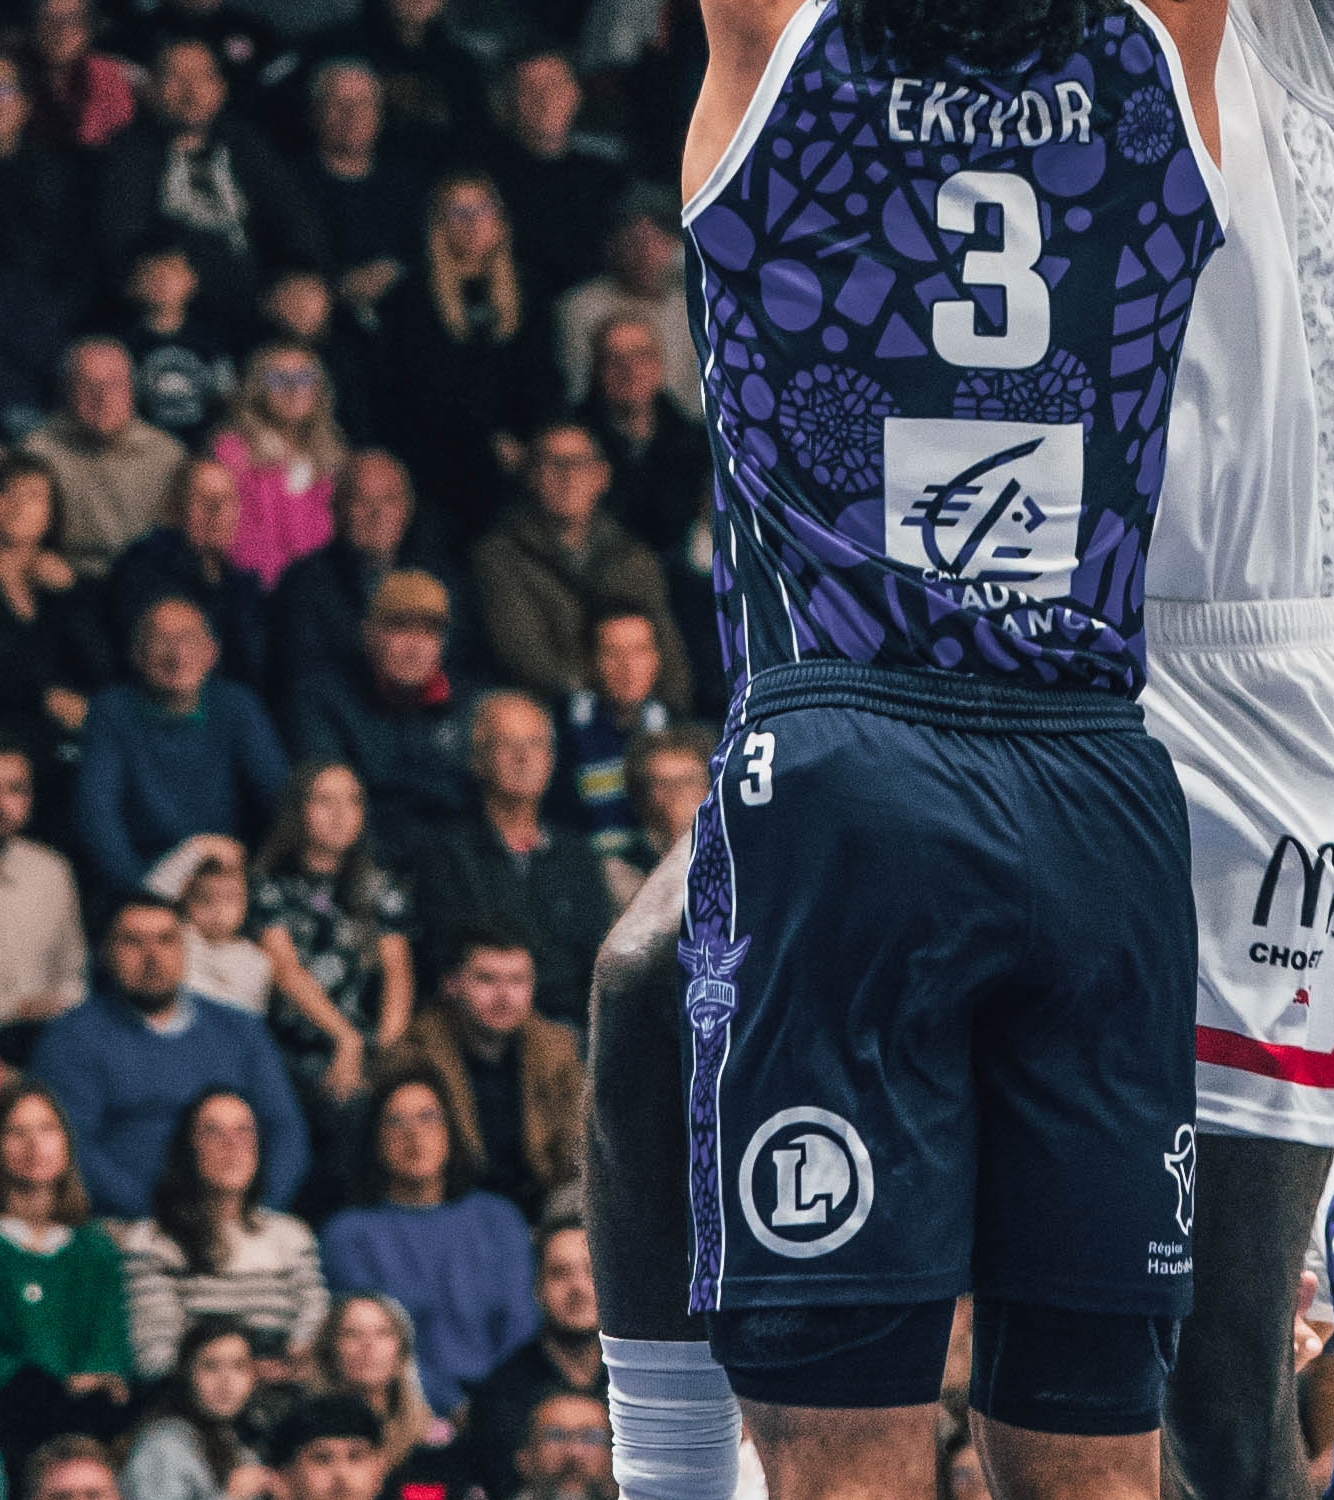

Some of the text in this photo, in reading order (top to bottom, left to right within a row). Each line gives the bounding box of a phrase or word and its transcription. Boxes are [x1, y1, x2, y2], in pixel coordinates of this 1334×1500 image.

[886, 77, 1093, 148] EKIYOR
[932, 170, 1052, 371] 3
[739, 731, 775, 806] 3
